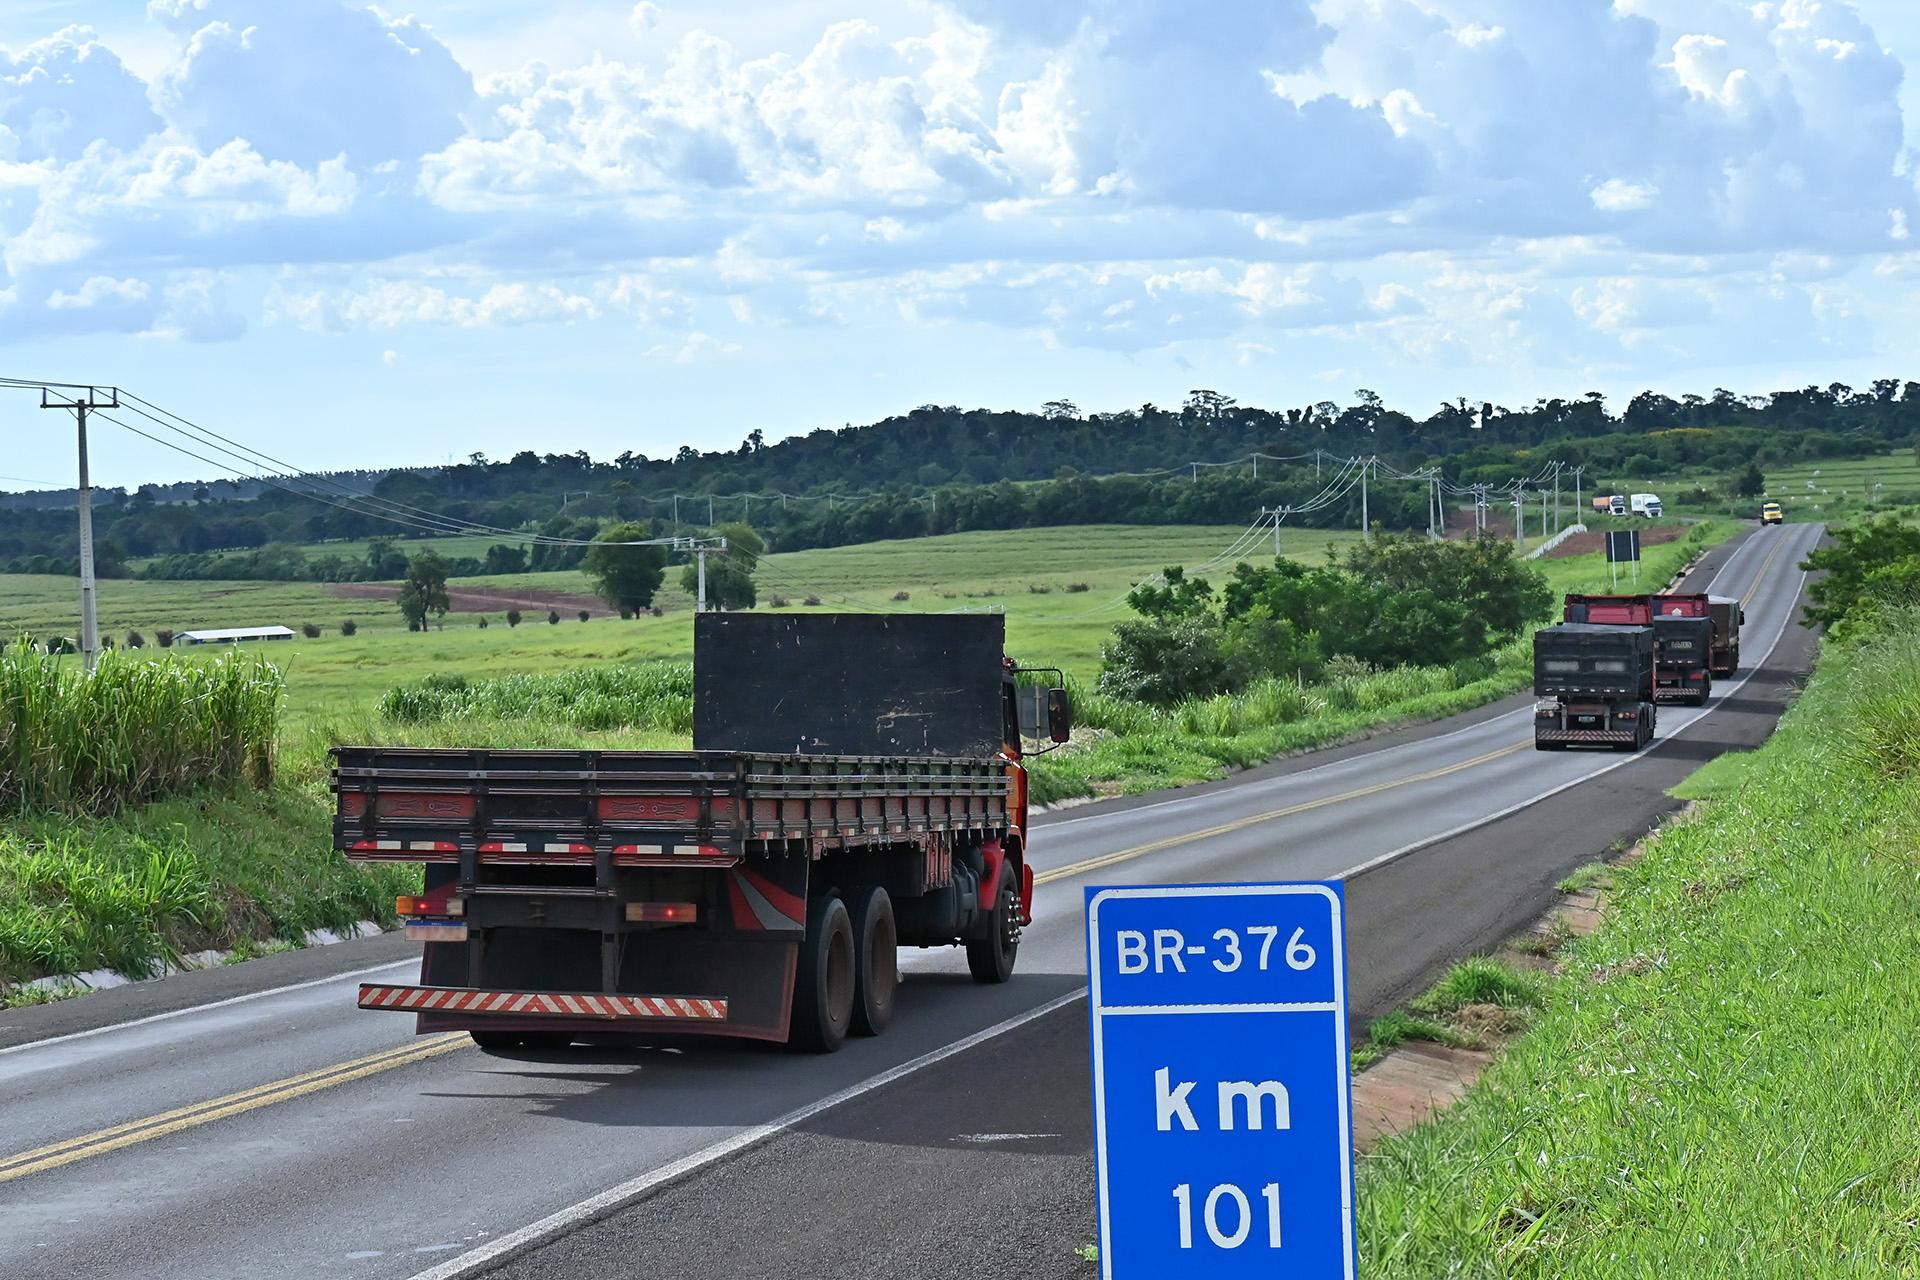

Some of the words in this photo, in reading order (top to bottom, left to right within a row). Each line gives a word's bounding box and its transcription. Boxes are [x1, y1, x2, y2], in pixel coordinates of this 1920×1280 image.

[1117, 926, 1316, 975] BR-376
[1154, 1066, 1291, 1131] km
[1172, 1182, 1282, 1249] 101
